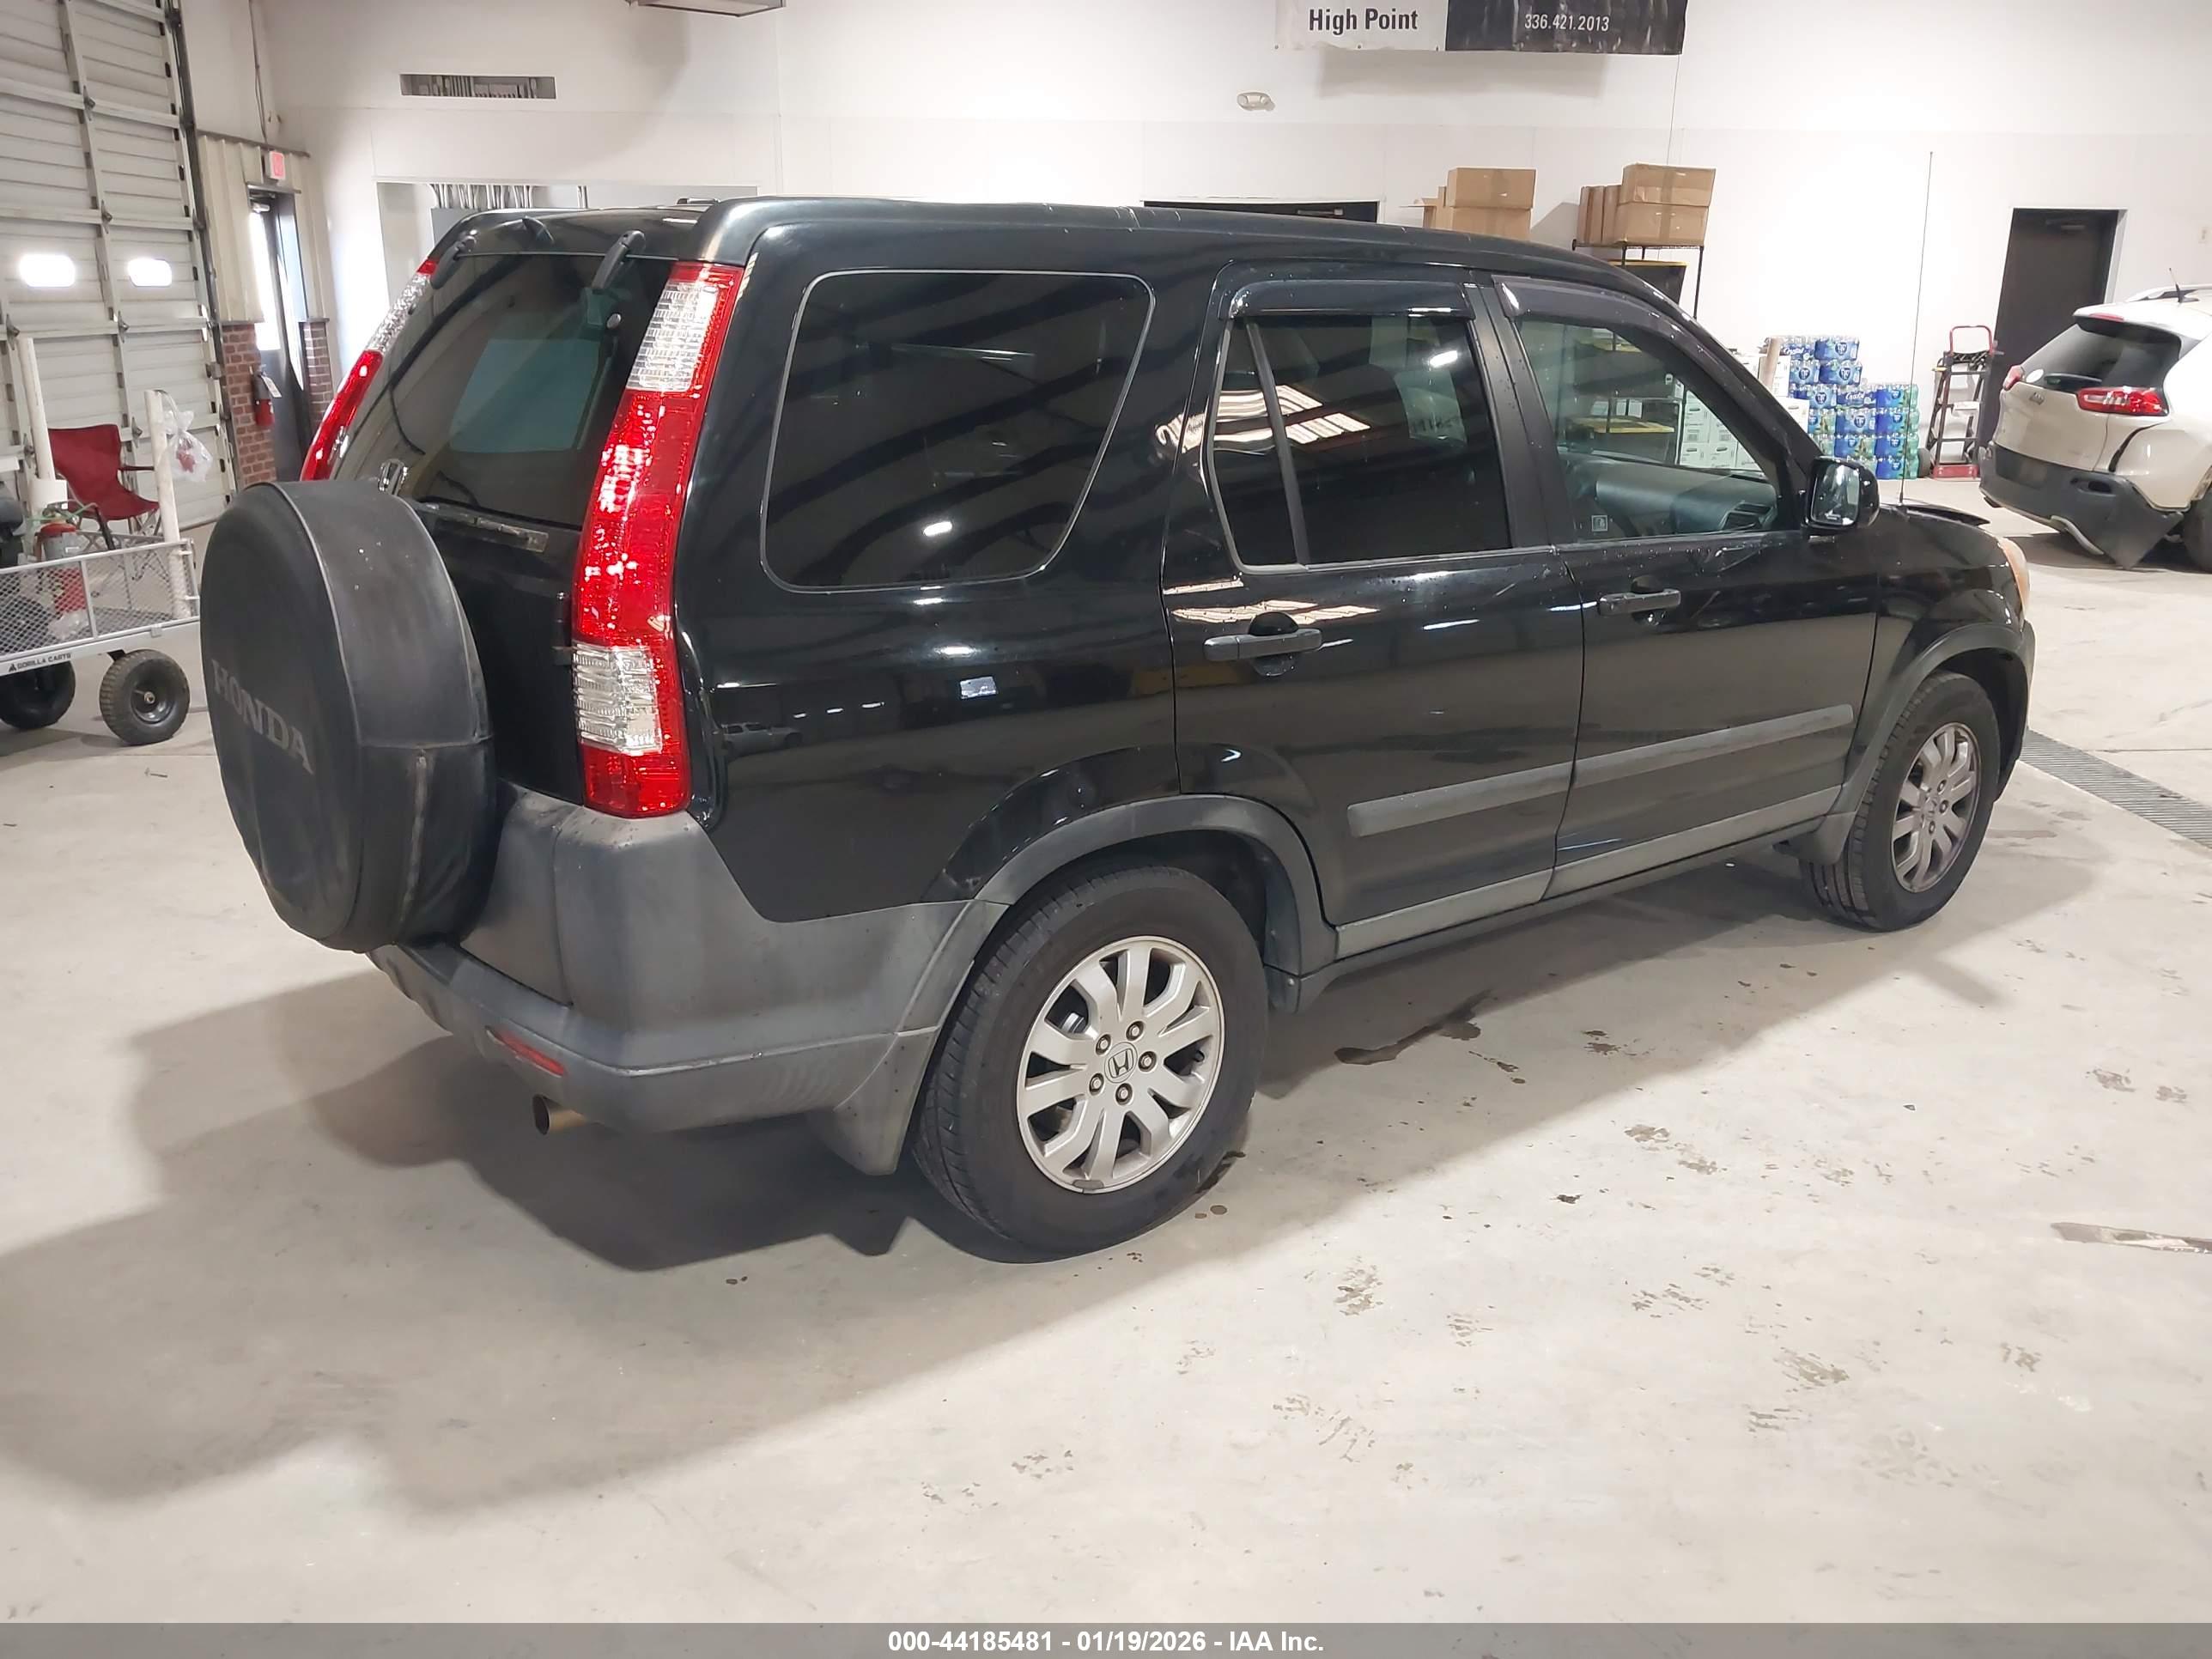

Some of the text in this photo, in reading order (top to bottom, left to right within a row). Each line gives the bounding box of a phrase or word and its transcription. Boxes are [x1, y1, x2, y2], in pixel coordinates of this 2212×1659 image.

[1309, 8, 1419, 35] High Point
[1524, 13, 1609, 32] 336.421.2013
[211, 658, 314, 775] HONDA
